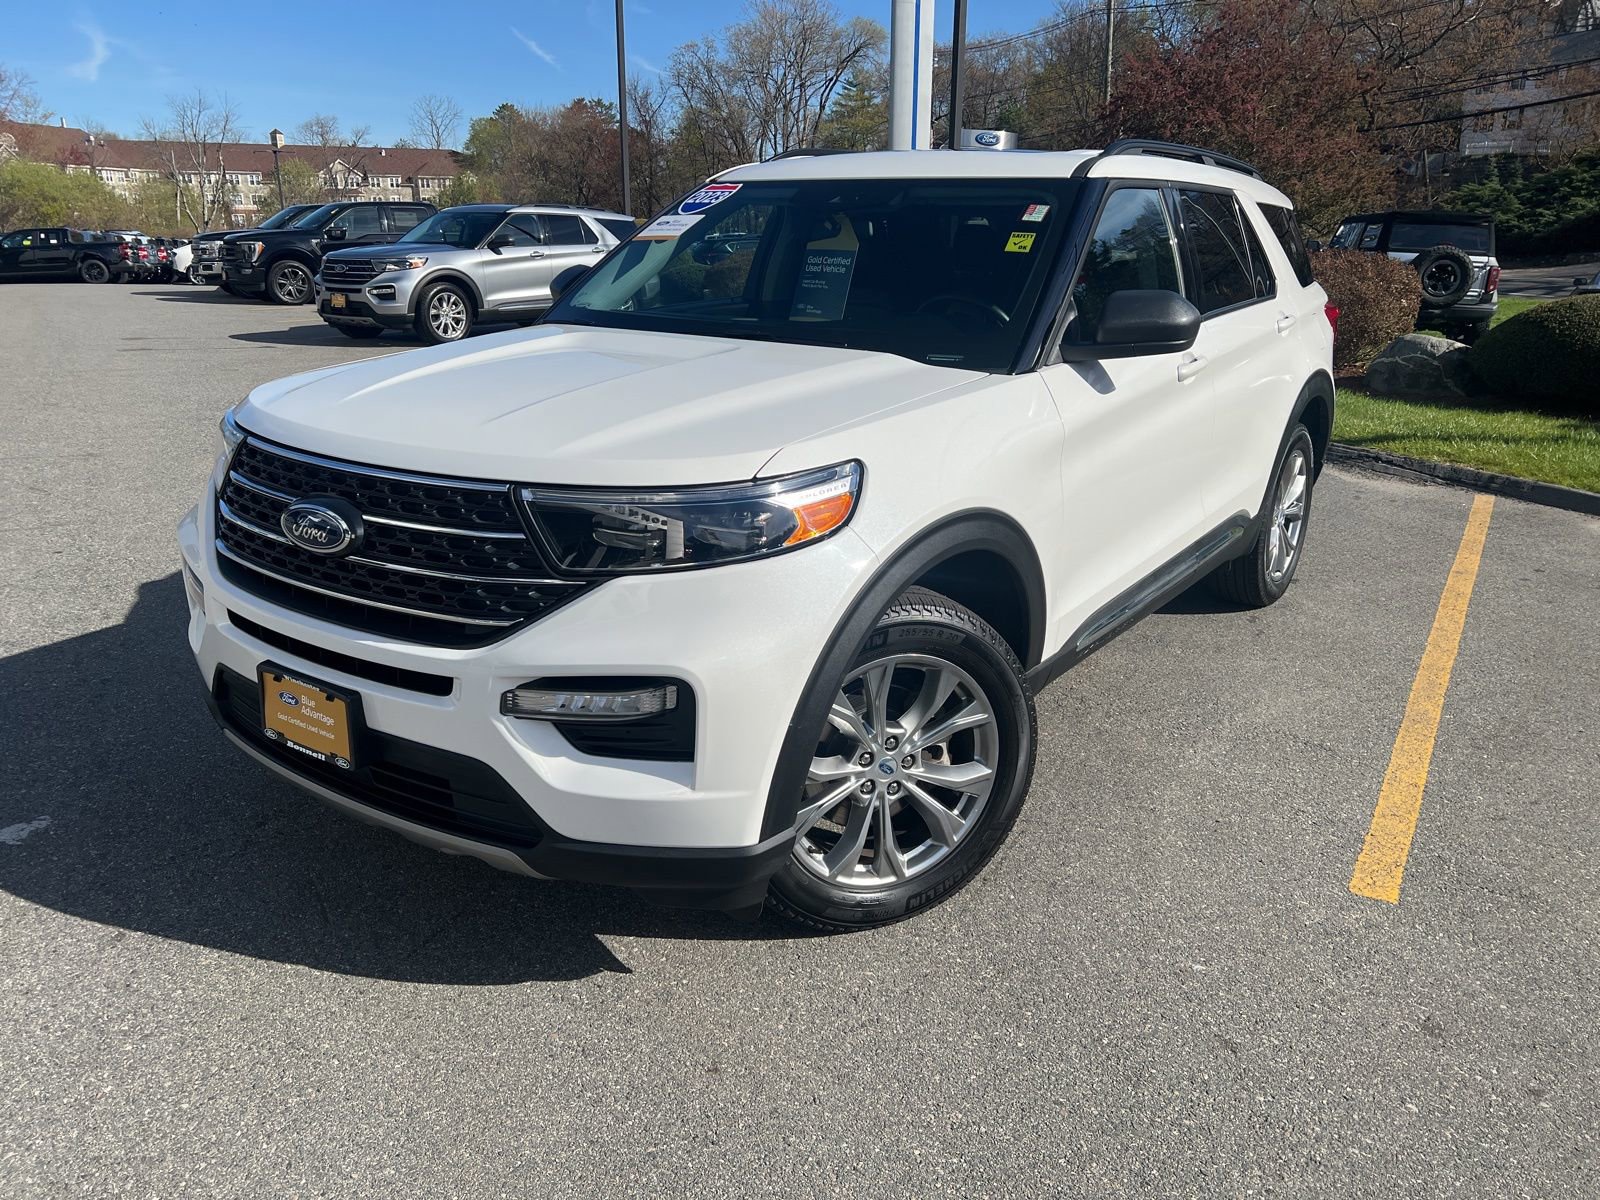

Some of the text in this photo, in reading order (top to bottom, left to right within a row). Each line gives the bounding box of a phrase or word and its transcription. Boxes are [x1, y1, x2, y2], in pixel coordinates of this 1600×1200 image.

[686, 191, 730, 204] 2023
[807, 256, 851, 265] Gold Certified
[805, 264, 846, 274] Used Vehicle
[799, 482, 848, 499] PLORER
[292, 513, 331, 543] Ford
[281, 691, 297, 706] Ford
[301, 695, 316, 708] Blue
[301, 706, 335, 726] Advantage
[277, 712, 335, 740] Gold Certified Used Vehicle
[287, 740, 326, 761] Bonnell
